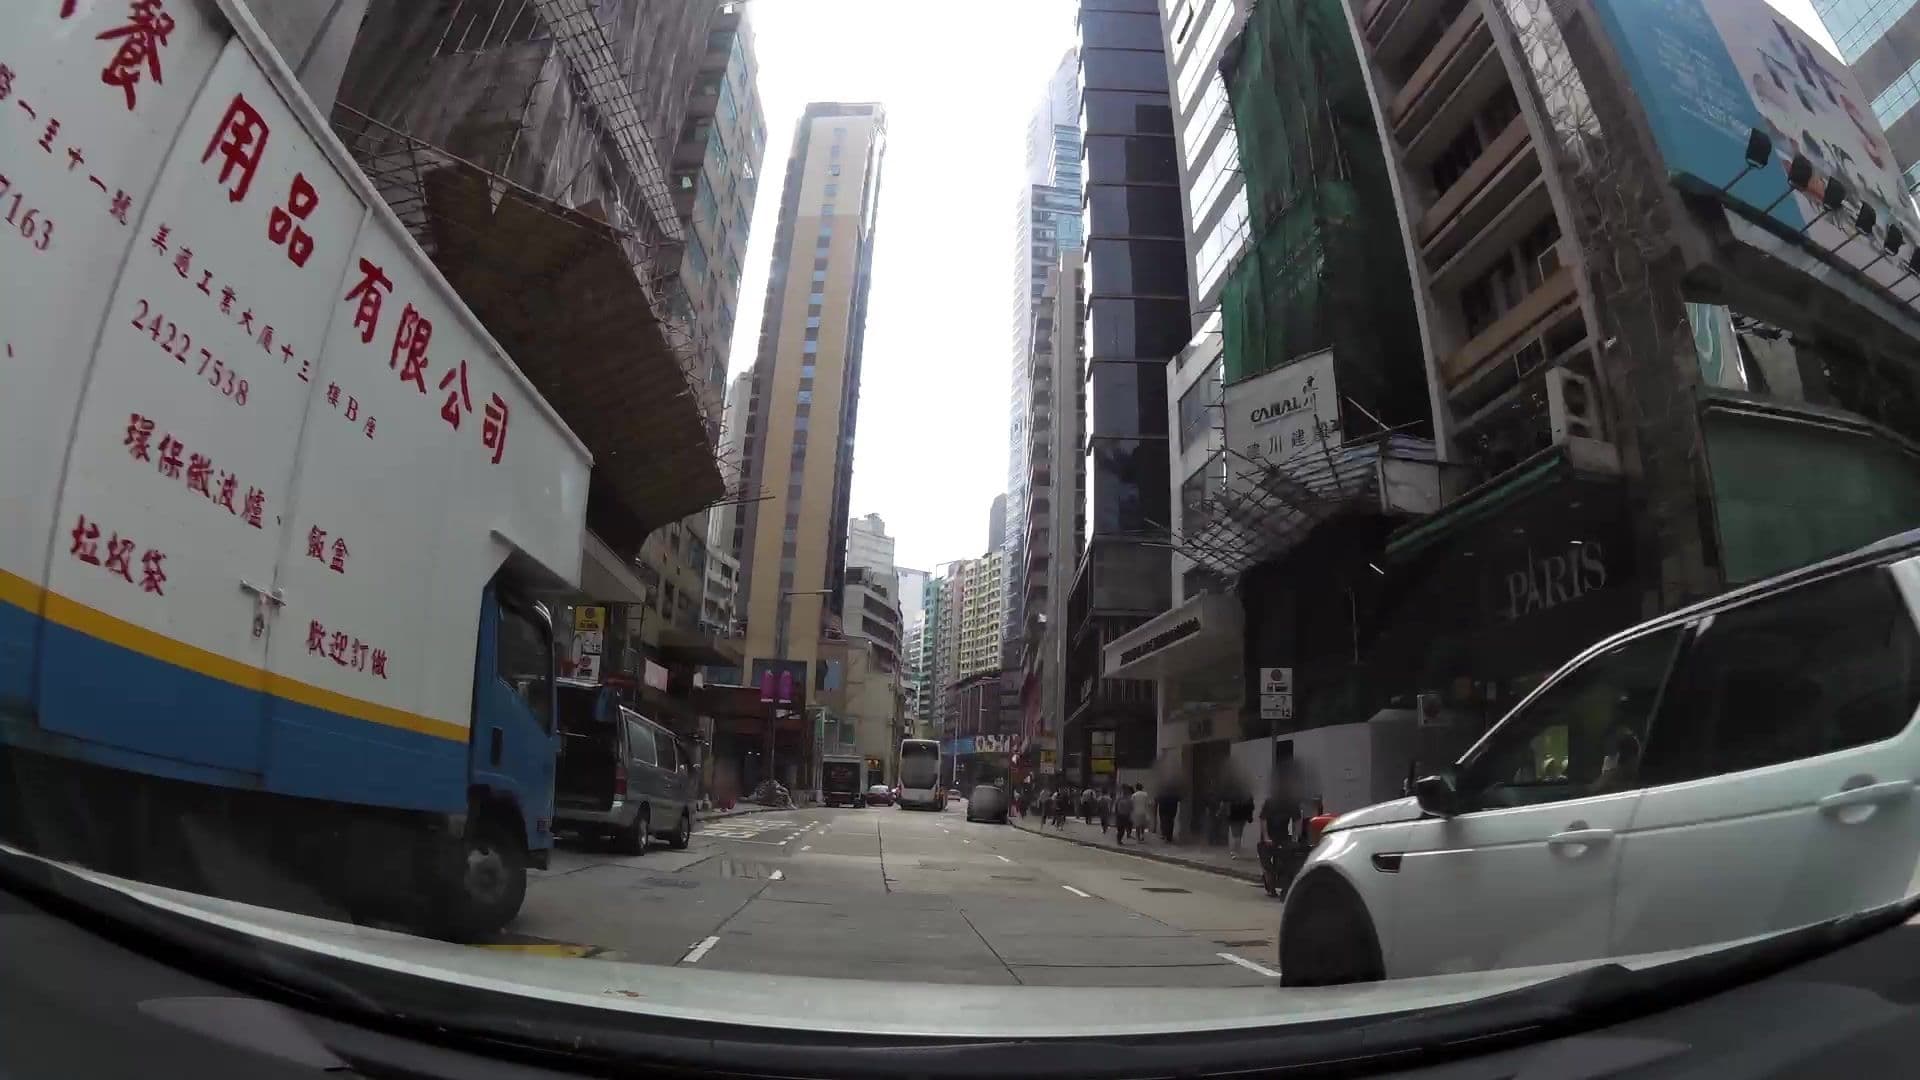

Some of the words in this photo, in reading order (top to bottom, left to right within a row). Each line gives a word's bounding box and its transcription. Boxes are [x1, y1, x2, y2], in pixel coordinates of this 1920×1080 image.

[60, 0, 508, 464] 餐用品有限公司
[131, 299, 191, 364] 2422
[197, 348, 249, 407] 7538
[1250, 397, 1302, 422] CANAL
[70, 513, 168, 596] 垃圾袋
[1505, 541, 1606, 618] PARIS
